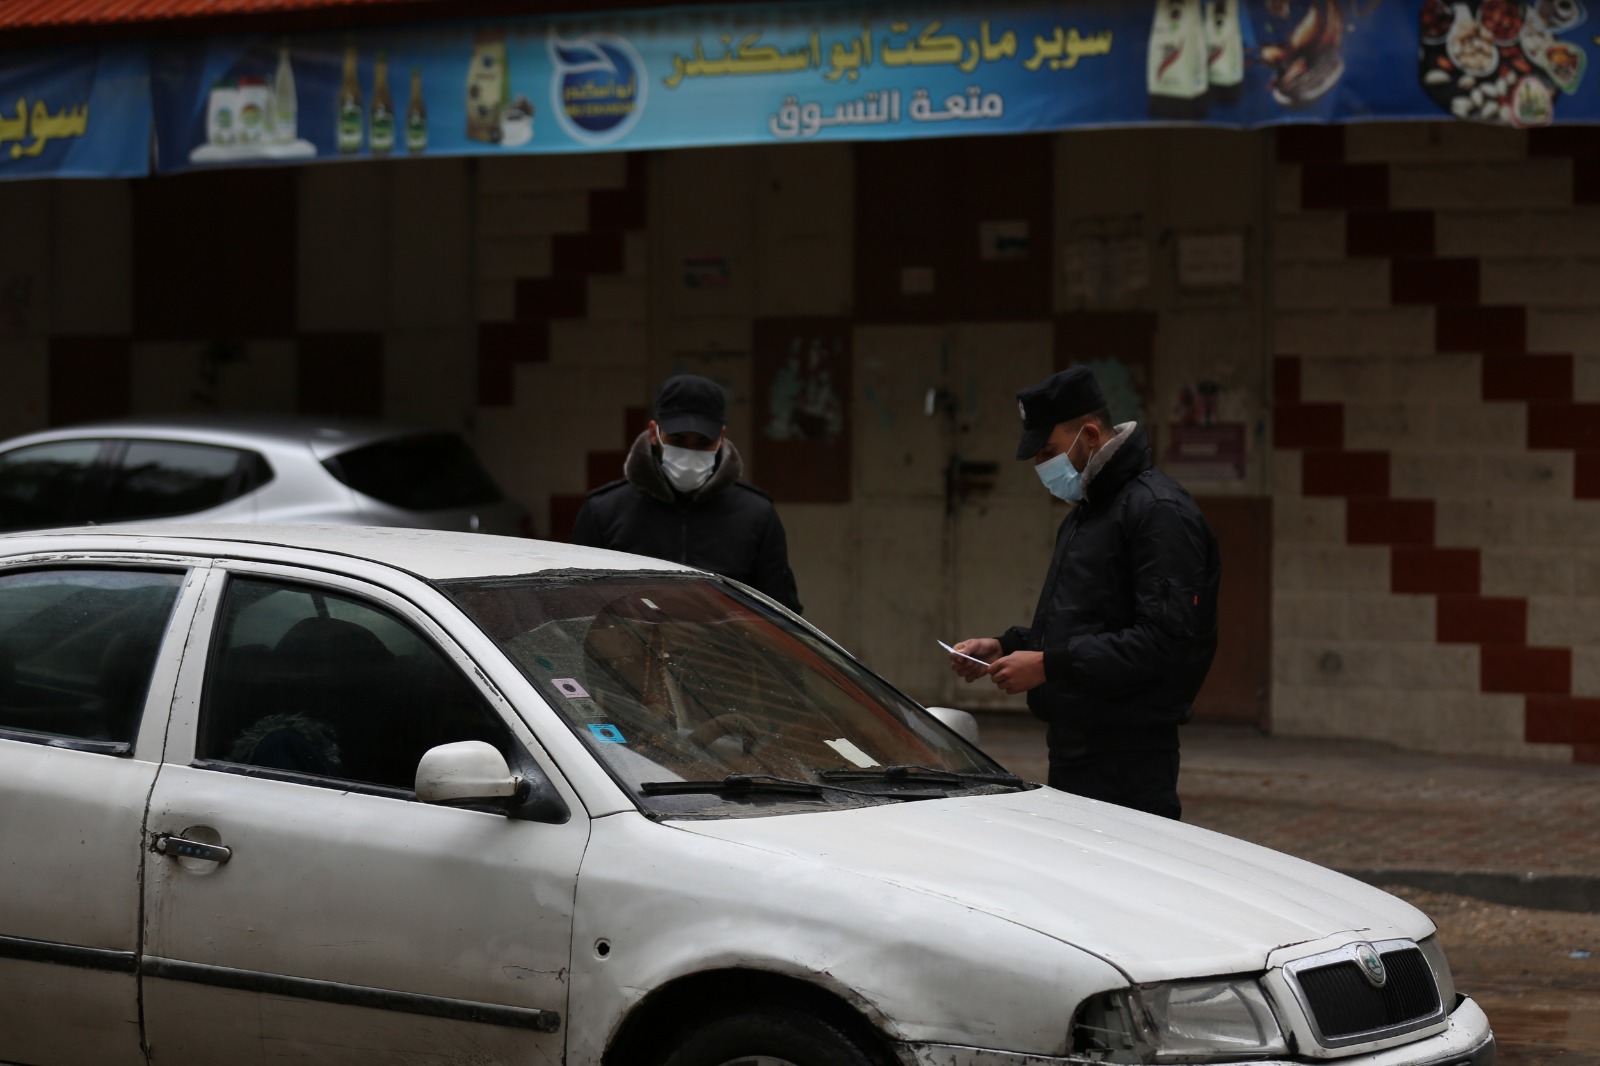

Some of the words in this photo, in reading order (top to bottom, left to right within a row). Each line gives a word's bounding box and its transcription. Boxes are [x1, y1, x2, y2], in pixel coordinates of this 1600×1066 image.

[881, 19, 1017, 73] ماركت
[1022, 25, 1113, 71] سوبر
[0, 95, 89, 160] سوب
[769, 88, 900, 137] التسوق
[908, 86, 1004, 122] متعة
